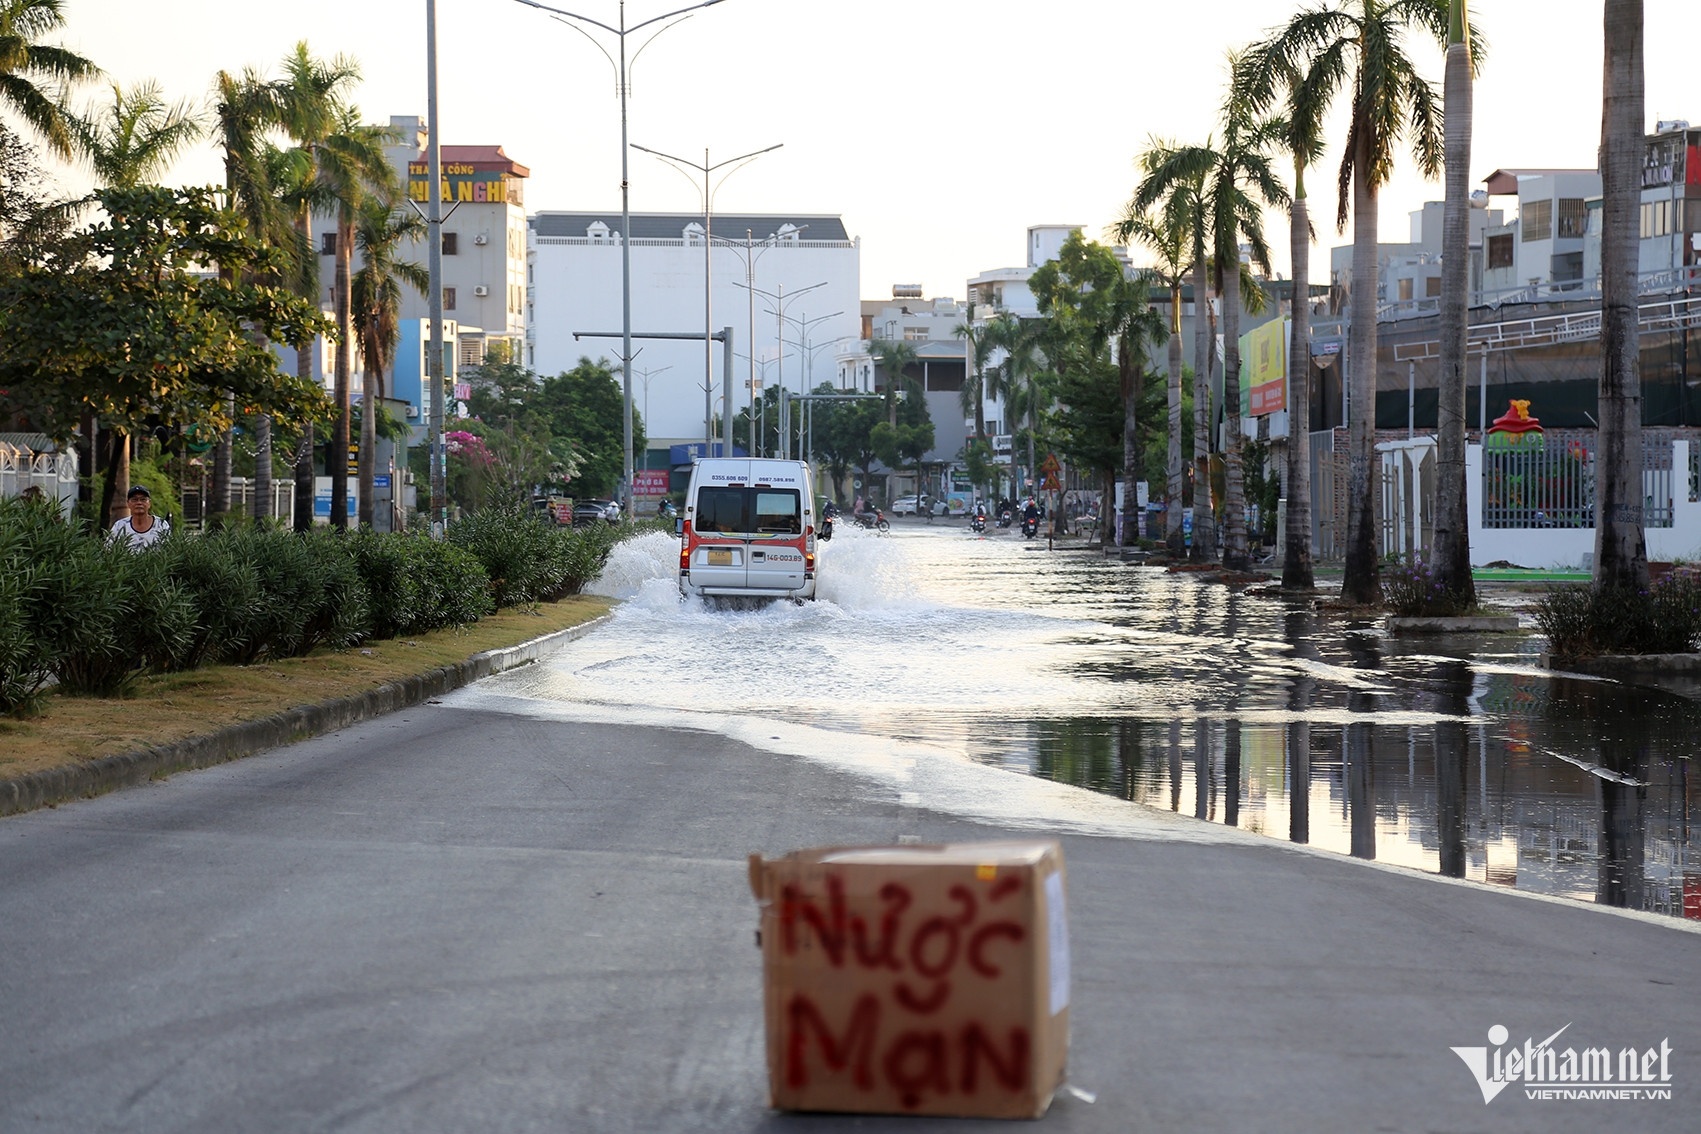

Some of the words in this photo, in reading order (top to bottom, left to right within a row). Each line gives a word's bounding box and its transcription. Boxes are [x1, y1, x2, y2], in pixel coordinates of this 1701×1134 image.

[409, 164, 444, 175] THA
[447, 162, 474, 175] CÔNG
[457, 173, 507, 202] NGHỈ
